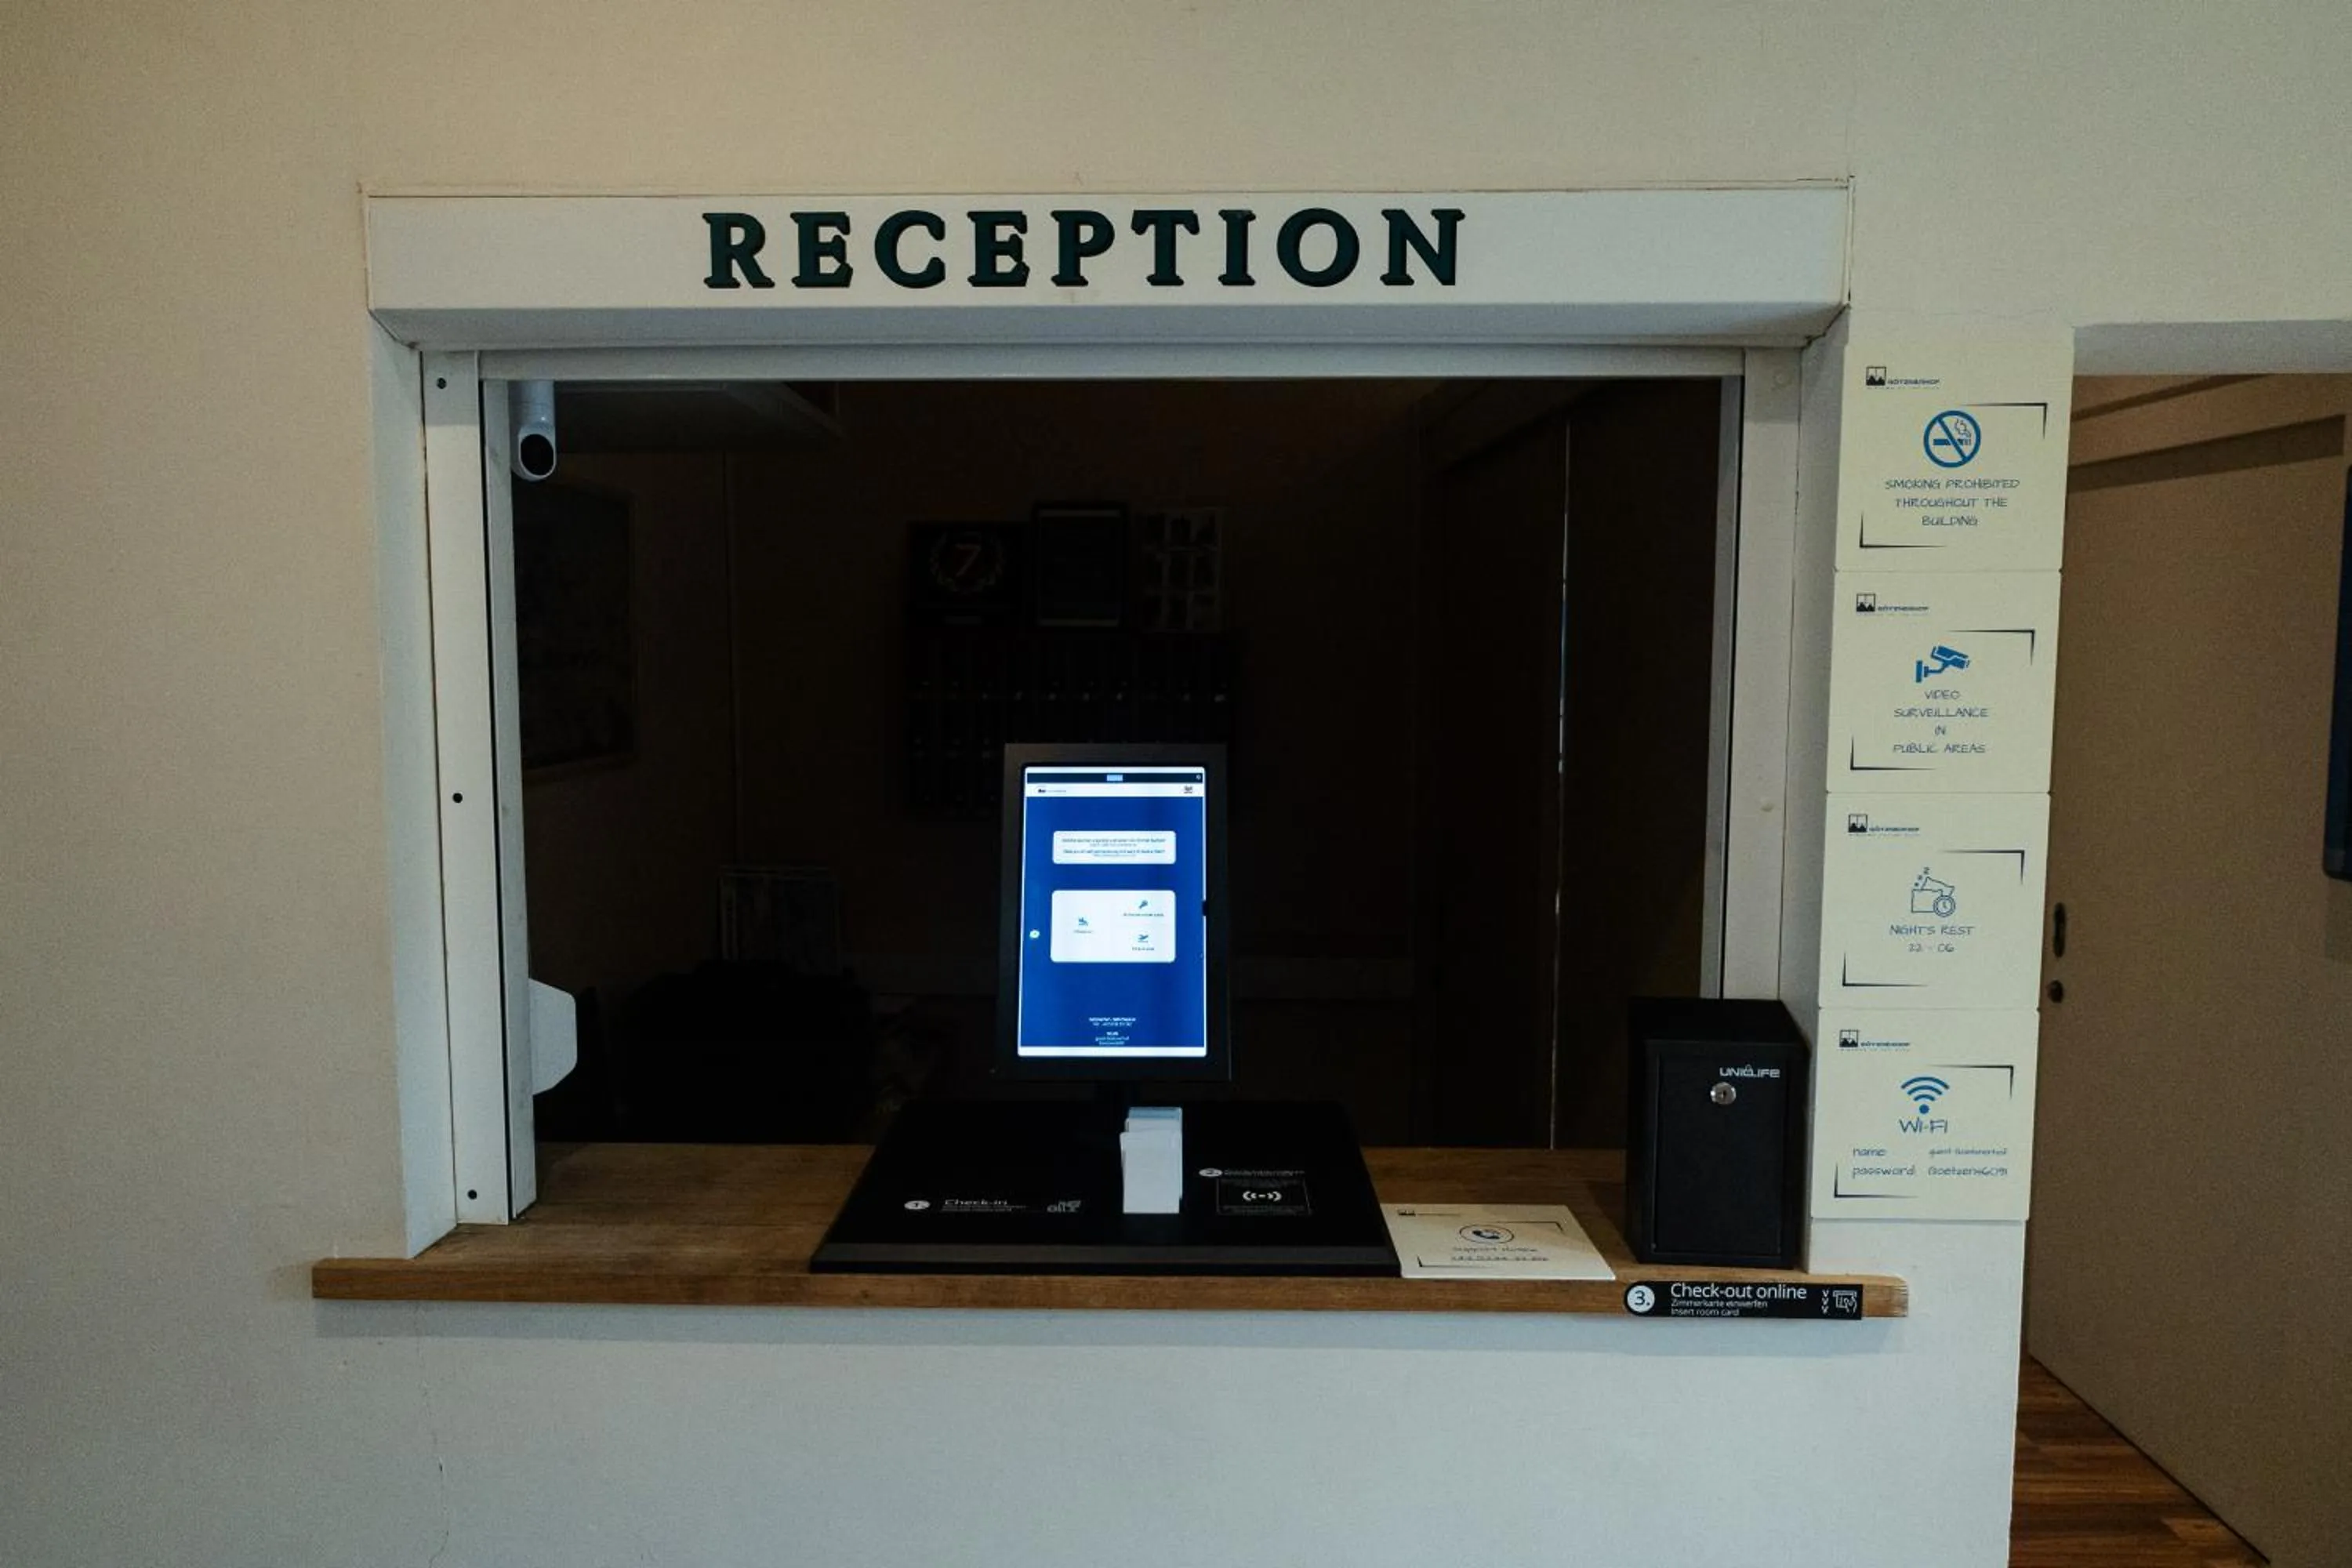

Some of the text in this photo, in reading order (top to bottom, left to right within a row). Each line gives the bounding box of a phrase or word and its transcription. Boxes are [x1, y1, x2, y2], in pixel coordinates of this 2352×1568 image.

[702, 208, 1465, 289] RECEPTION
[1885, 478, 2020, 490] SMOKING PROHIBITED
[1896, 497, 2008, 508] THROUGHOUT THE
[1922, 515, 1978, 526] BUILDING
[1924, 689, 1961, 700] VIDEO
[1893, 708, 1989, 717] SURVEILLANCE
[1934, 725, 1947, 735] IN
[1893, 742, 1986, 753] PUBLIC AREAS
[1940, 925, 1975, 935] REST
[1671, 1282, 1753, 1298] Check-out
[1755, 1283, 1807, 1299] online
